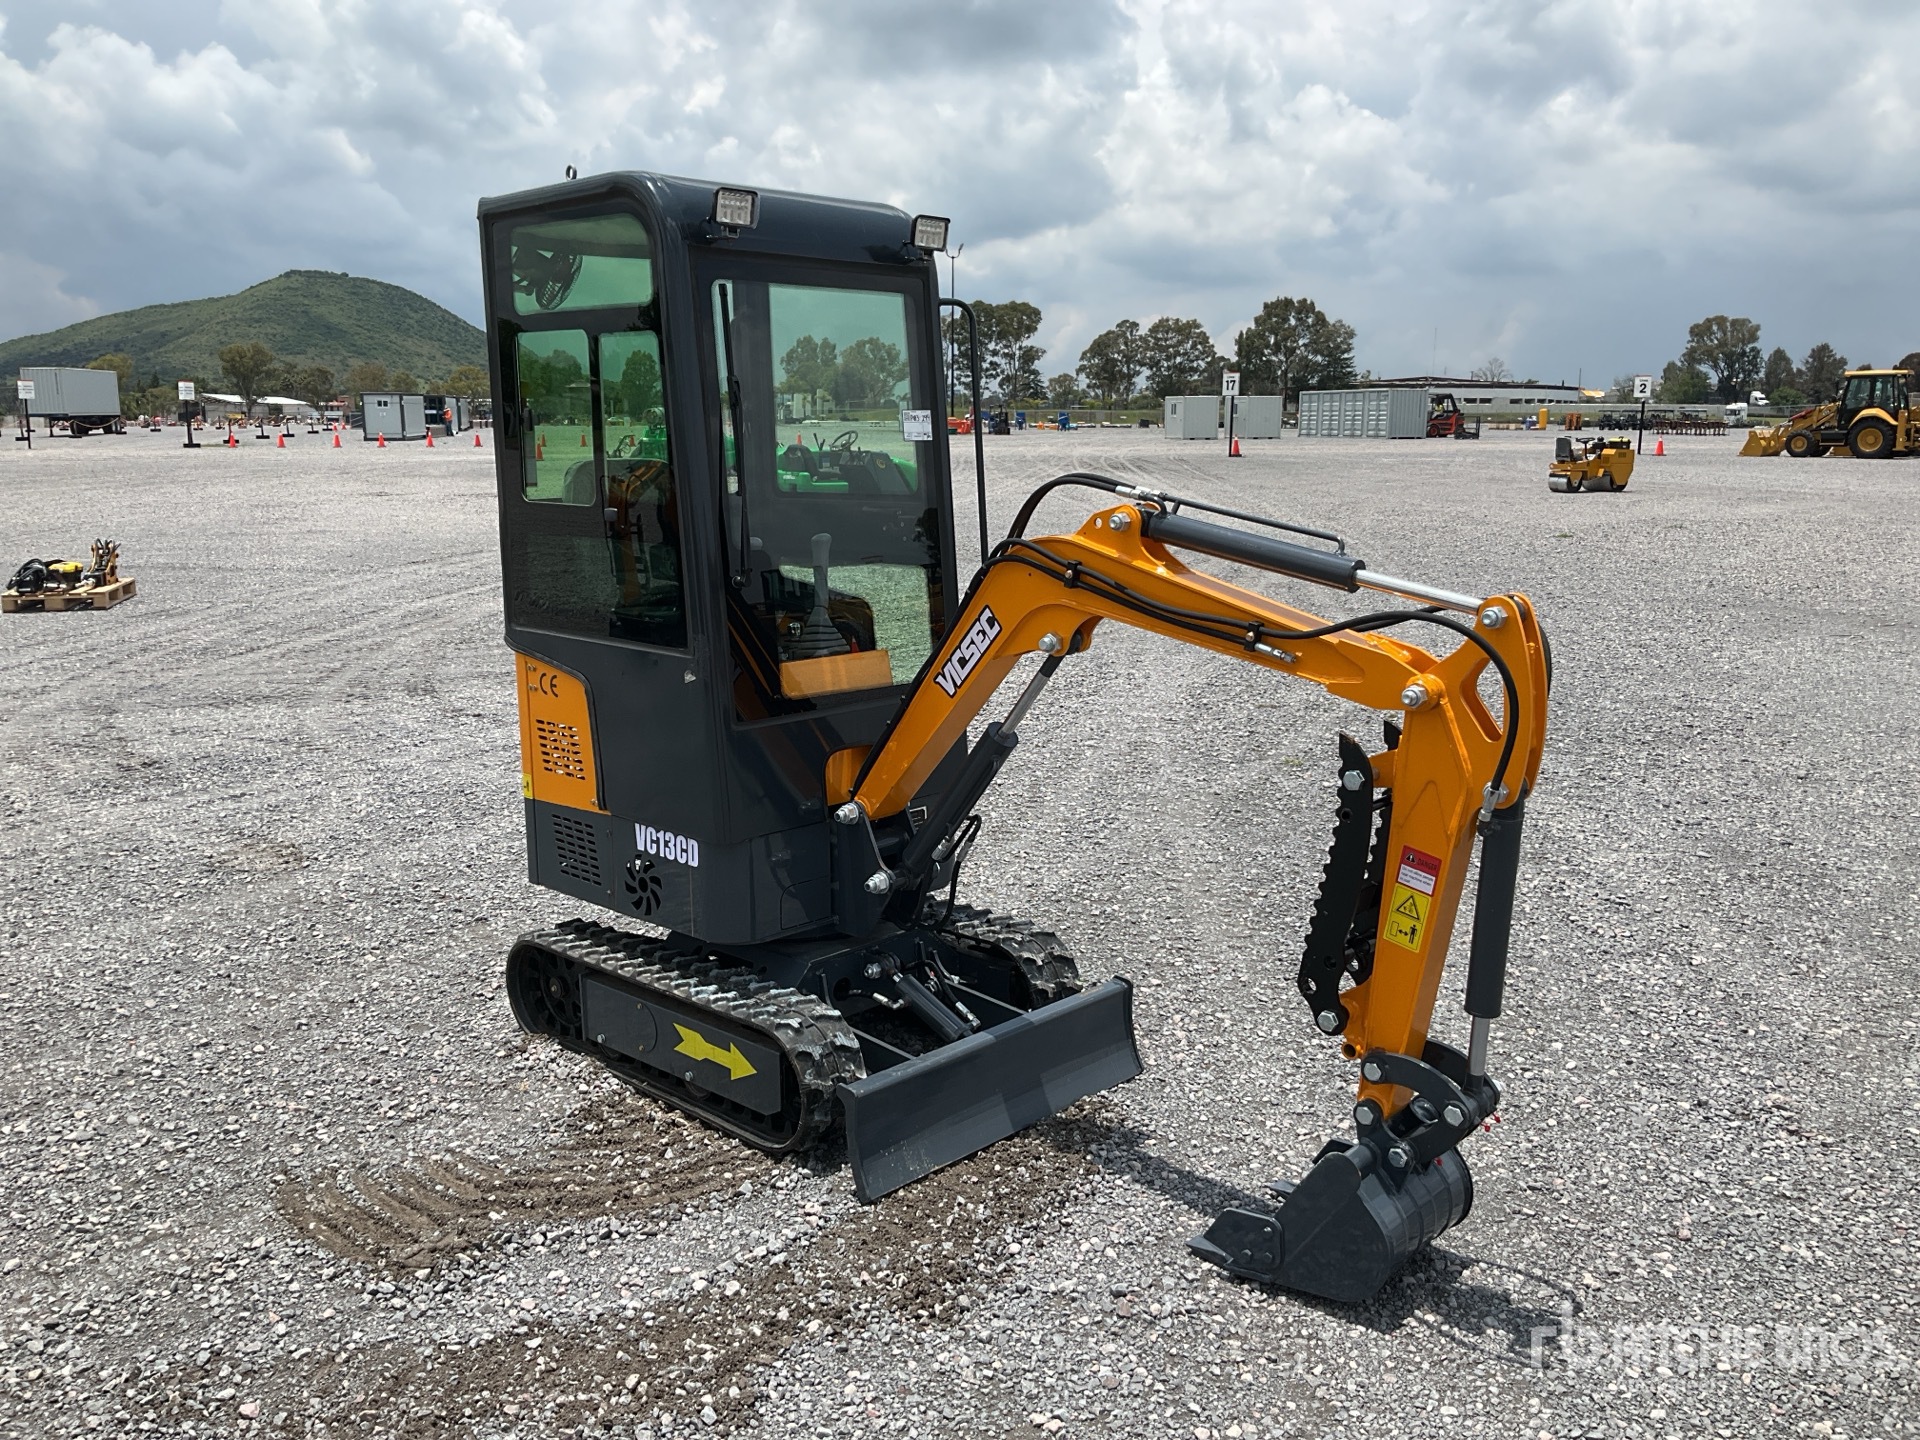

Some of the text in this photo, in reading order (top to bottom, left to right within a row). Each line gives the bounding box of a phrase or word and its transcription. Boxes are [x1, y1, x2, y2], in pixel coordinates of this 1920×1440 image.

[1225, 379, 1236, 391] 17
[1639, 383, 1647, 394] 2
[934, 605, 1002, 698] VICSEC
[634, 822, 699, 868] VC13CD
[1417, 858, 1438, 871] DANGER
